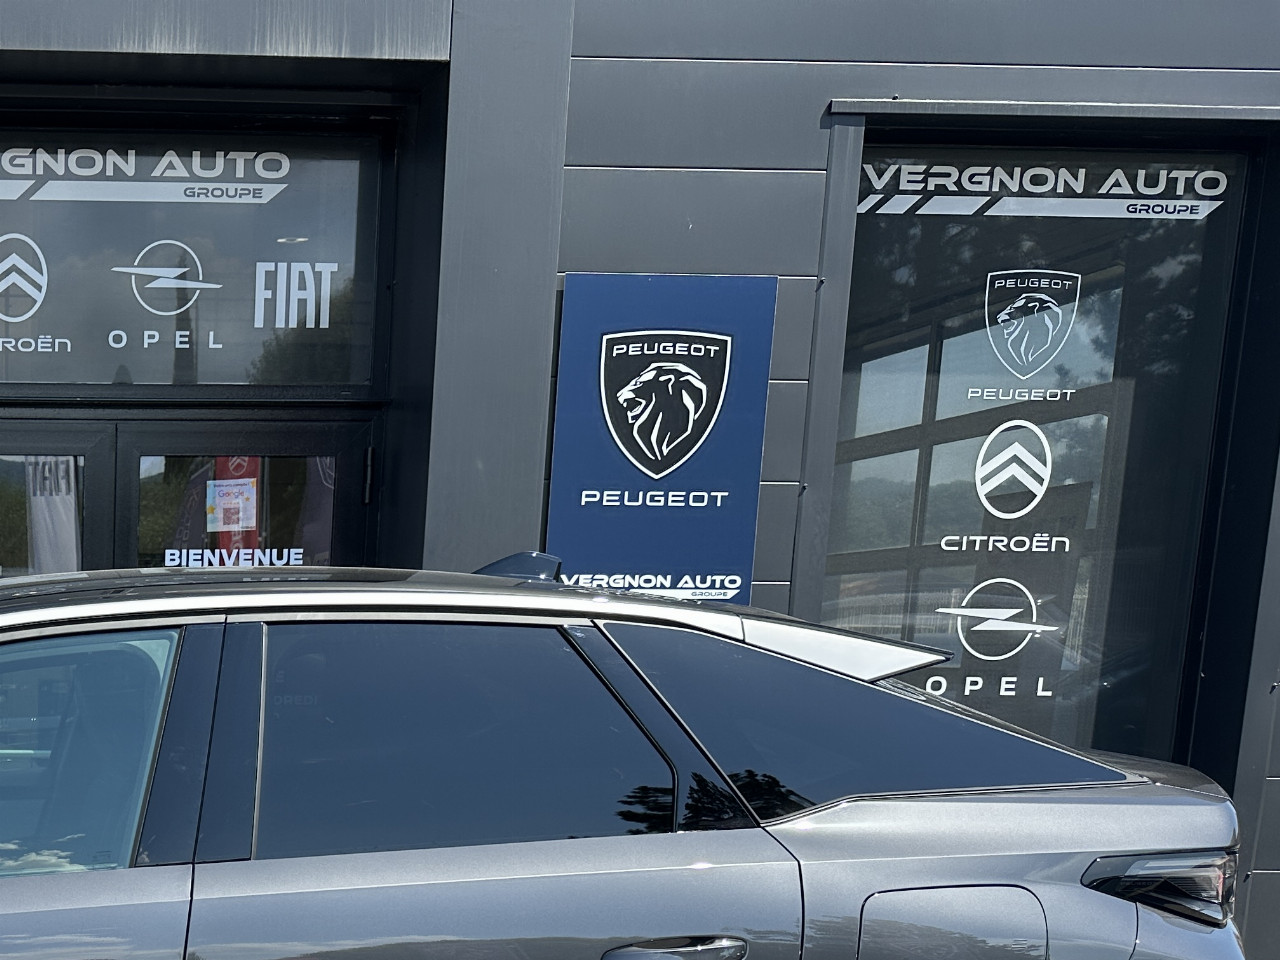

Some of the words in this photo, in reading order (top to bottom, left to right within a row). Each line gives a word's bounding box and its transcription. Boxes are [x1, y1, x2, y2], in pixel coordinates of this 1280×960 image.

[150, 149, 291, 179] AUTO
[862, 164, 1085, 194] VERGNON
[1097, 168, 1228, 196] AUTO
[183, 186, 264, 199] GROUPE
[1126, 202, 1201, 216] GROUPE
[994, 278, 1073, 290] PEUGEOT
[253, 262, 340, 330] FIAT
[108, 330, 223, 349] OPEL
[612, 342, 720, 358] PEUGEOT
[967, 388, 1077, 401] PEUGEOT
[580, 489, 729, 507] PEUGEOT
[940, 532, 1070, 553] CITROËN
[164, 548, 304, 567] BIENVENUE
[560, 574, 671, 589] VERGNON
[676, 574, 742, 589] AUTO
[925, 676, 1053, 696] OPEL
